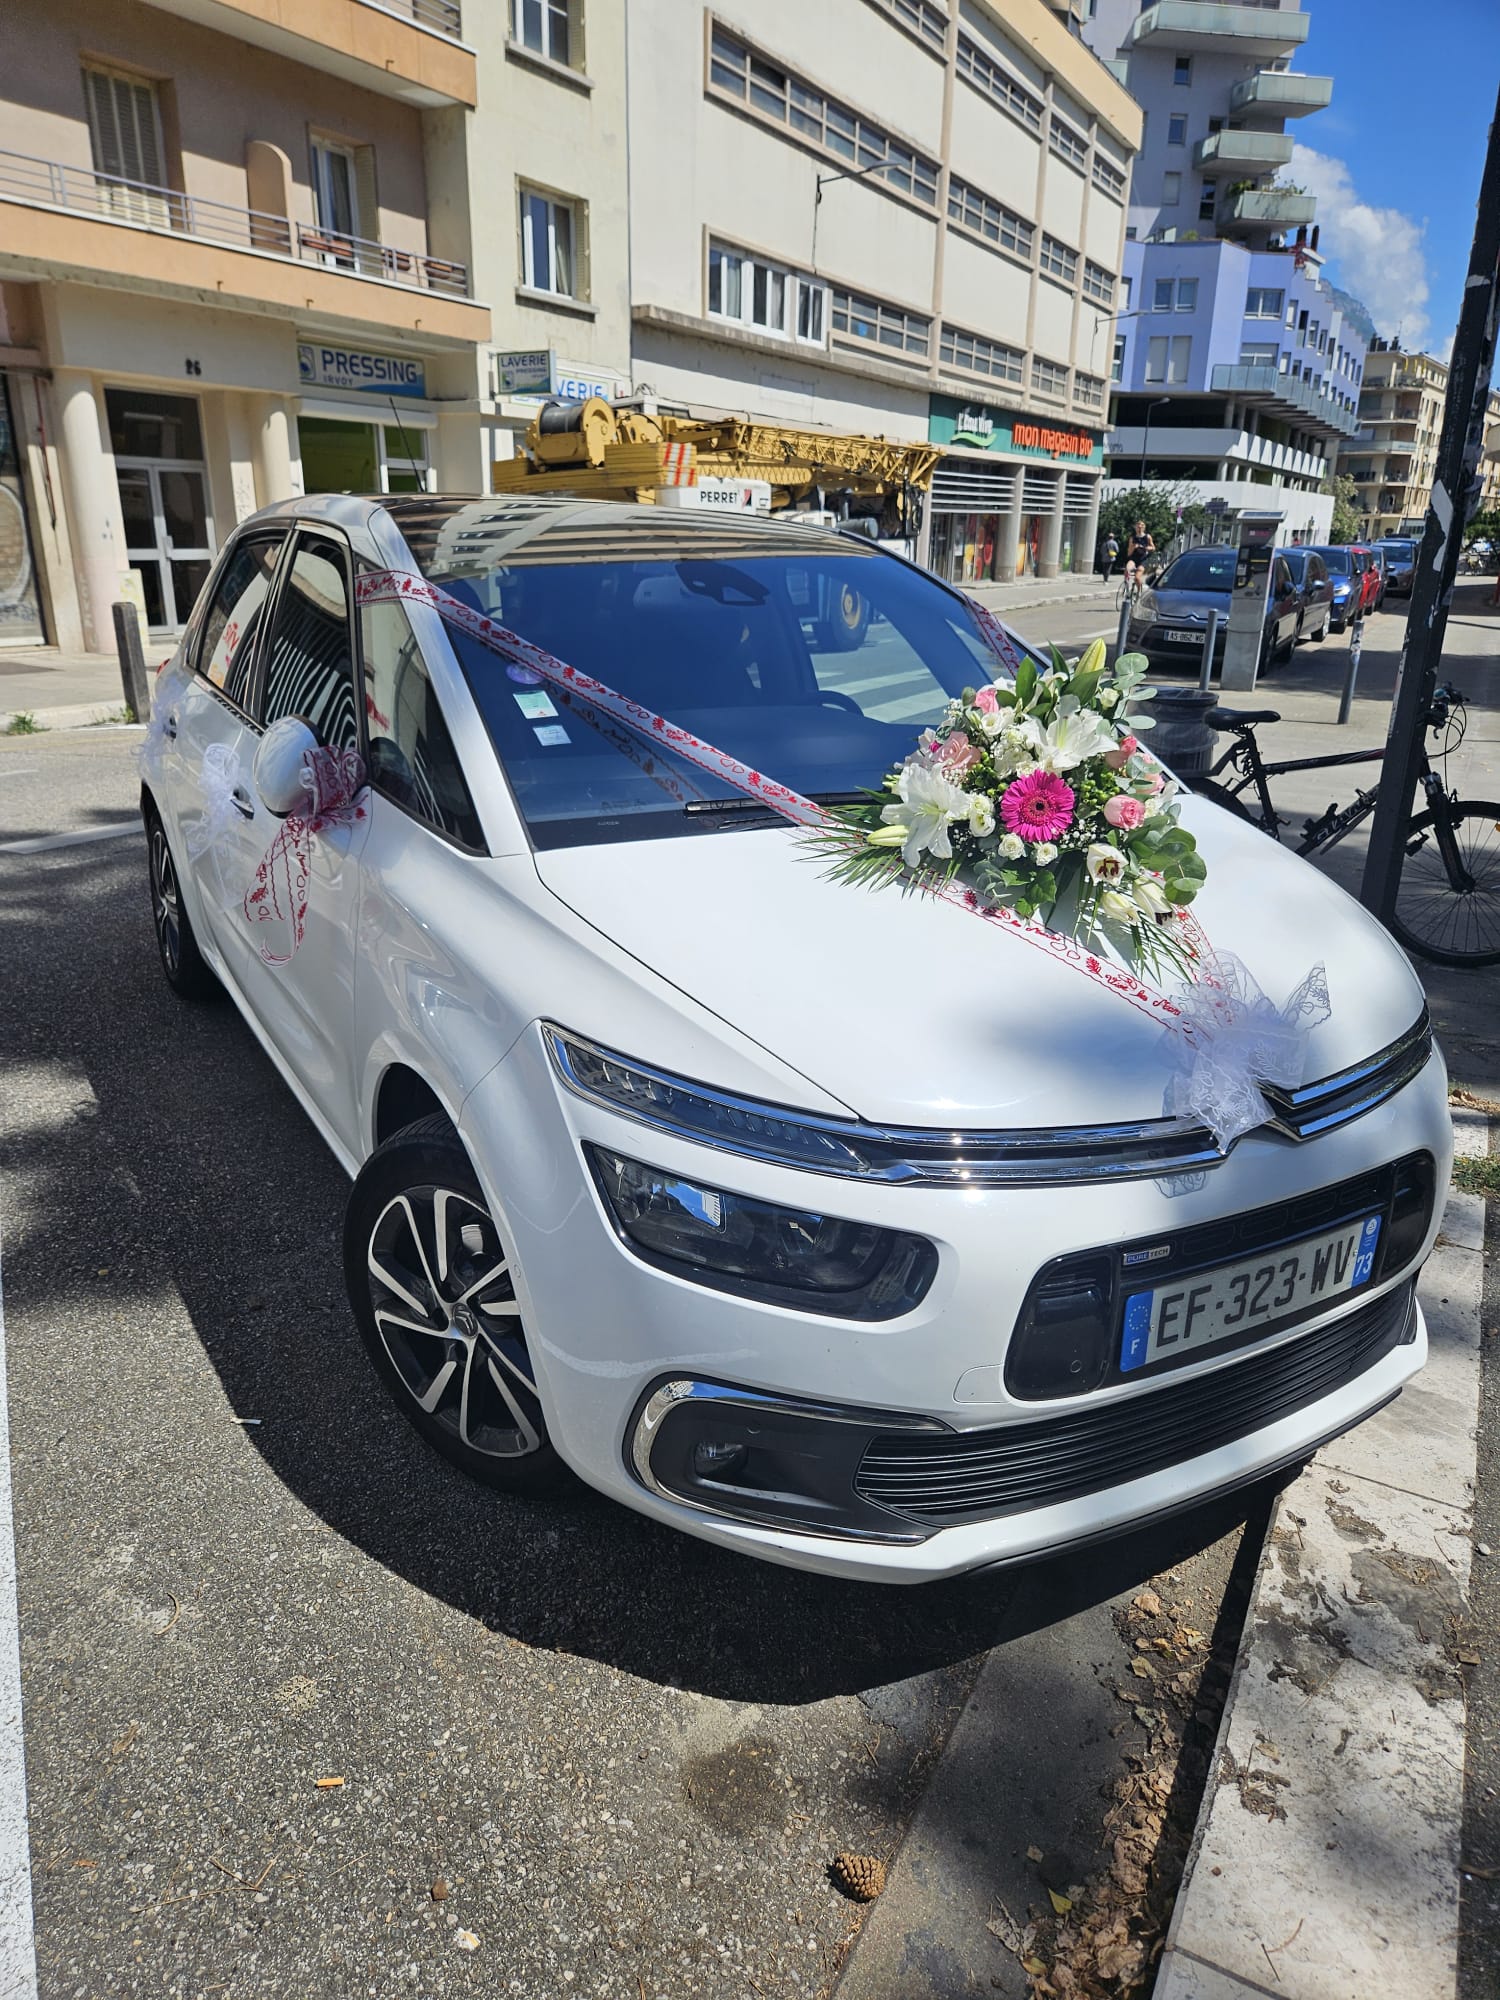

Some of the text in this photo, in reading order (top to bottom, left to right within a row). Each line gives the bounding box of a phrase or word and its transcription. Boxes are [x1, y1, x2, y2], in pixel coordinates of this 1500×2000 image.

[321, 349, 417, 383] PRESSING
[500, 354, 547, 368] LAVERIE
[1013, 423, 1039, 447] mon
[1040, 428, 1078, 459] magasin
[700, 490, 738, 504] PERRET
[1127, 1247, 1169, 1263] PURE TECH
[1355, 1251, 1374, 1278] 73
[1130, 1338, 1141, 1356] F
